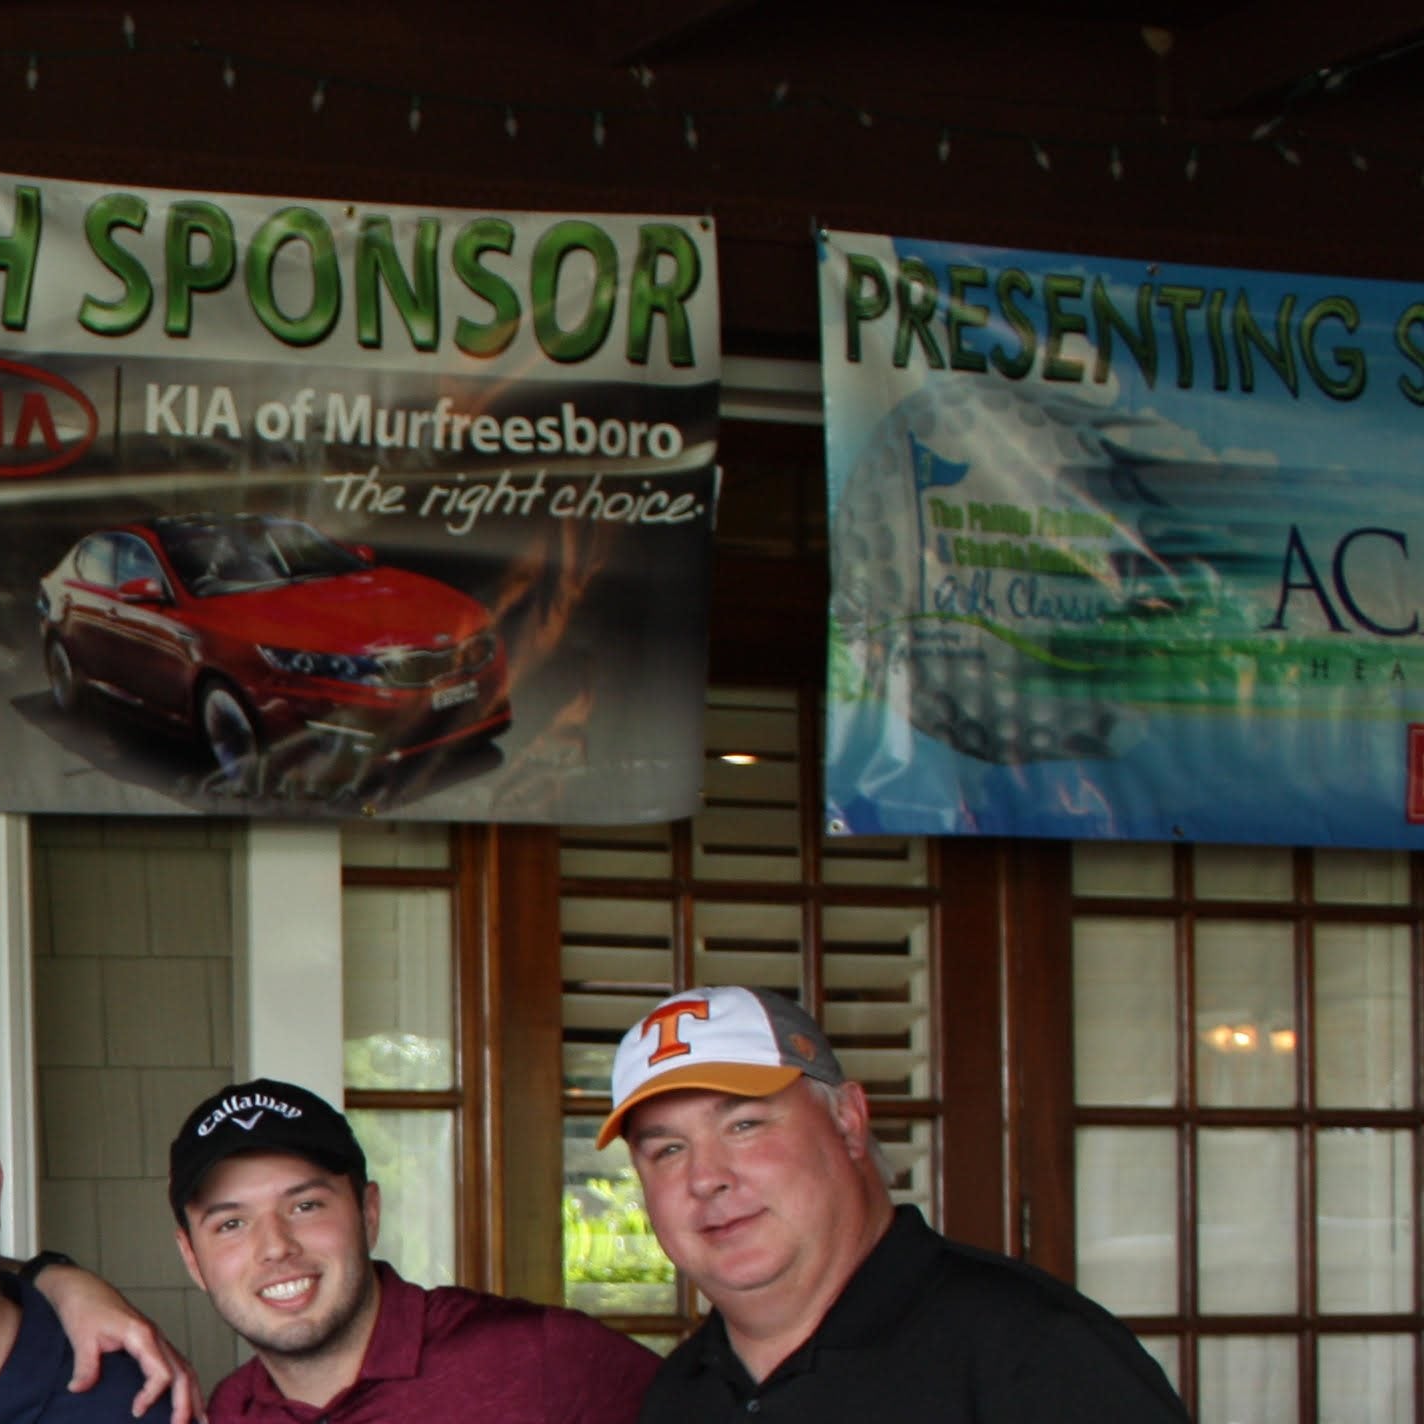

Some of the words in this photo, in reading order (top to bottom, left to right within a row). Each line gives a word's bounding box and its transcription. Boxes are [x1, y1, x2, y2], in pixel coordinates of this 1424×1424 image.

[77, 193, 702, 367] SPONSOR
[844, 254, 1366, 400] PRESENTING
[145, 384, 240, 440] KIA
[255, 387, 316, 441] of
[324, 392, 683, 457] Murfreesboro
[323, 466, 406, 513] The
[419, 469, 547, 536] right
[641, 1000, 709, 1067] T
[197, 1093, 302, 1136] Callaway
